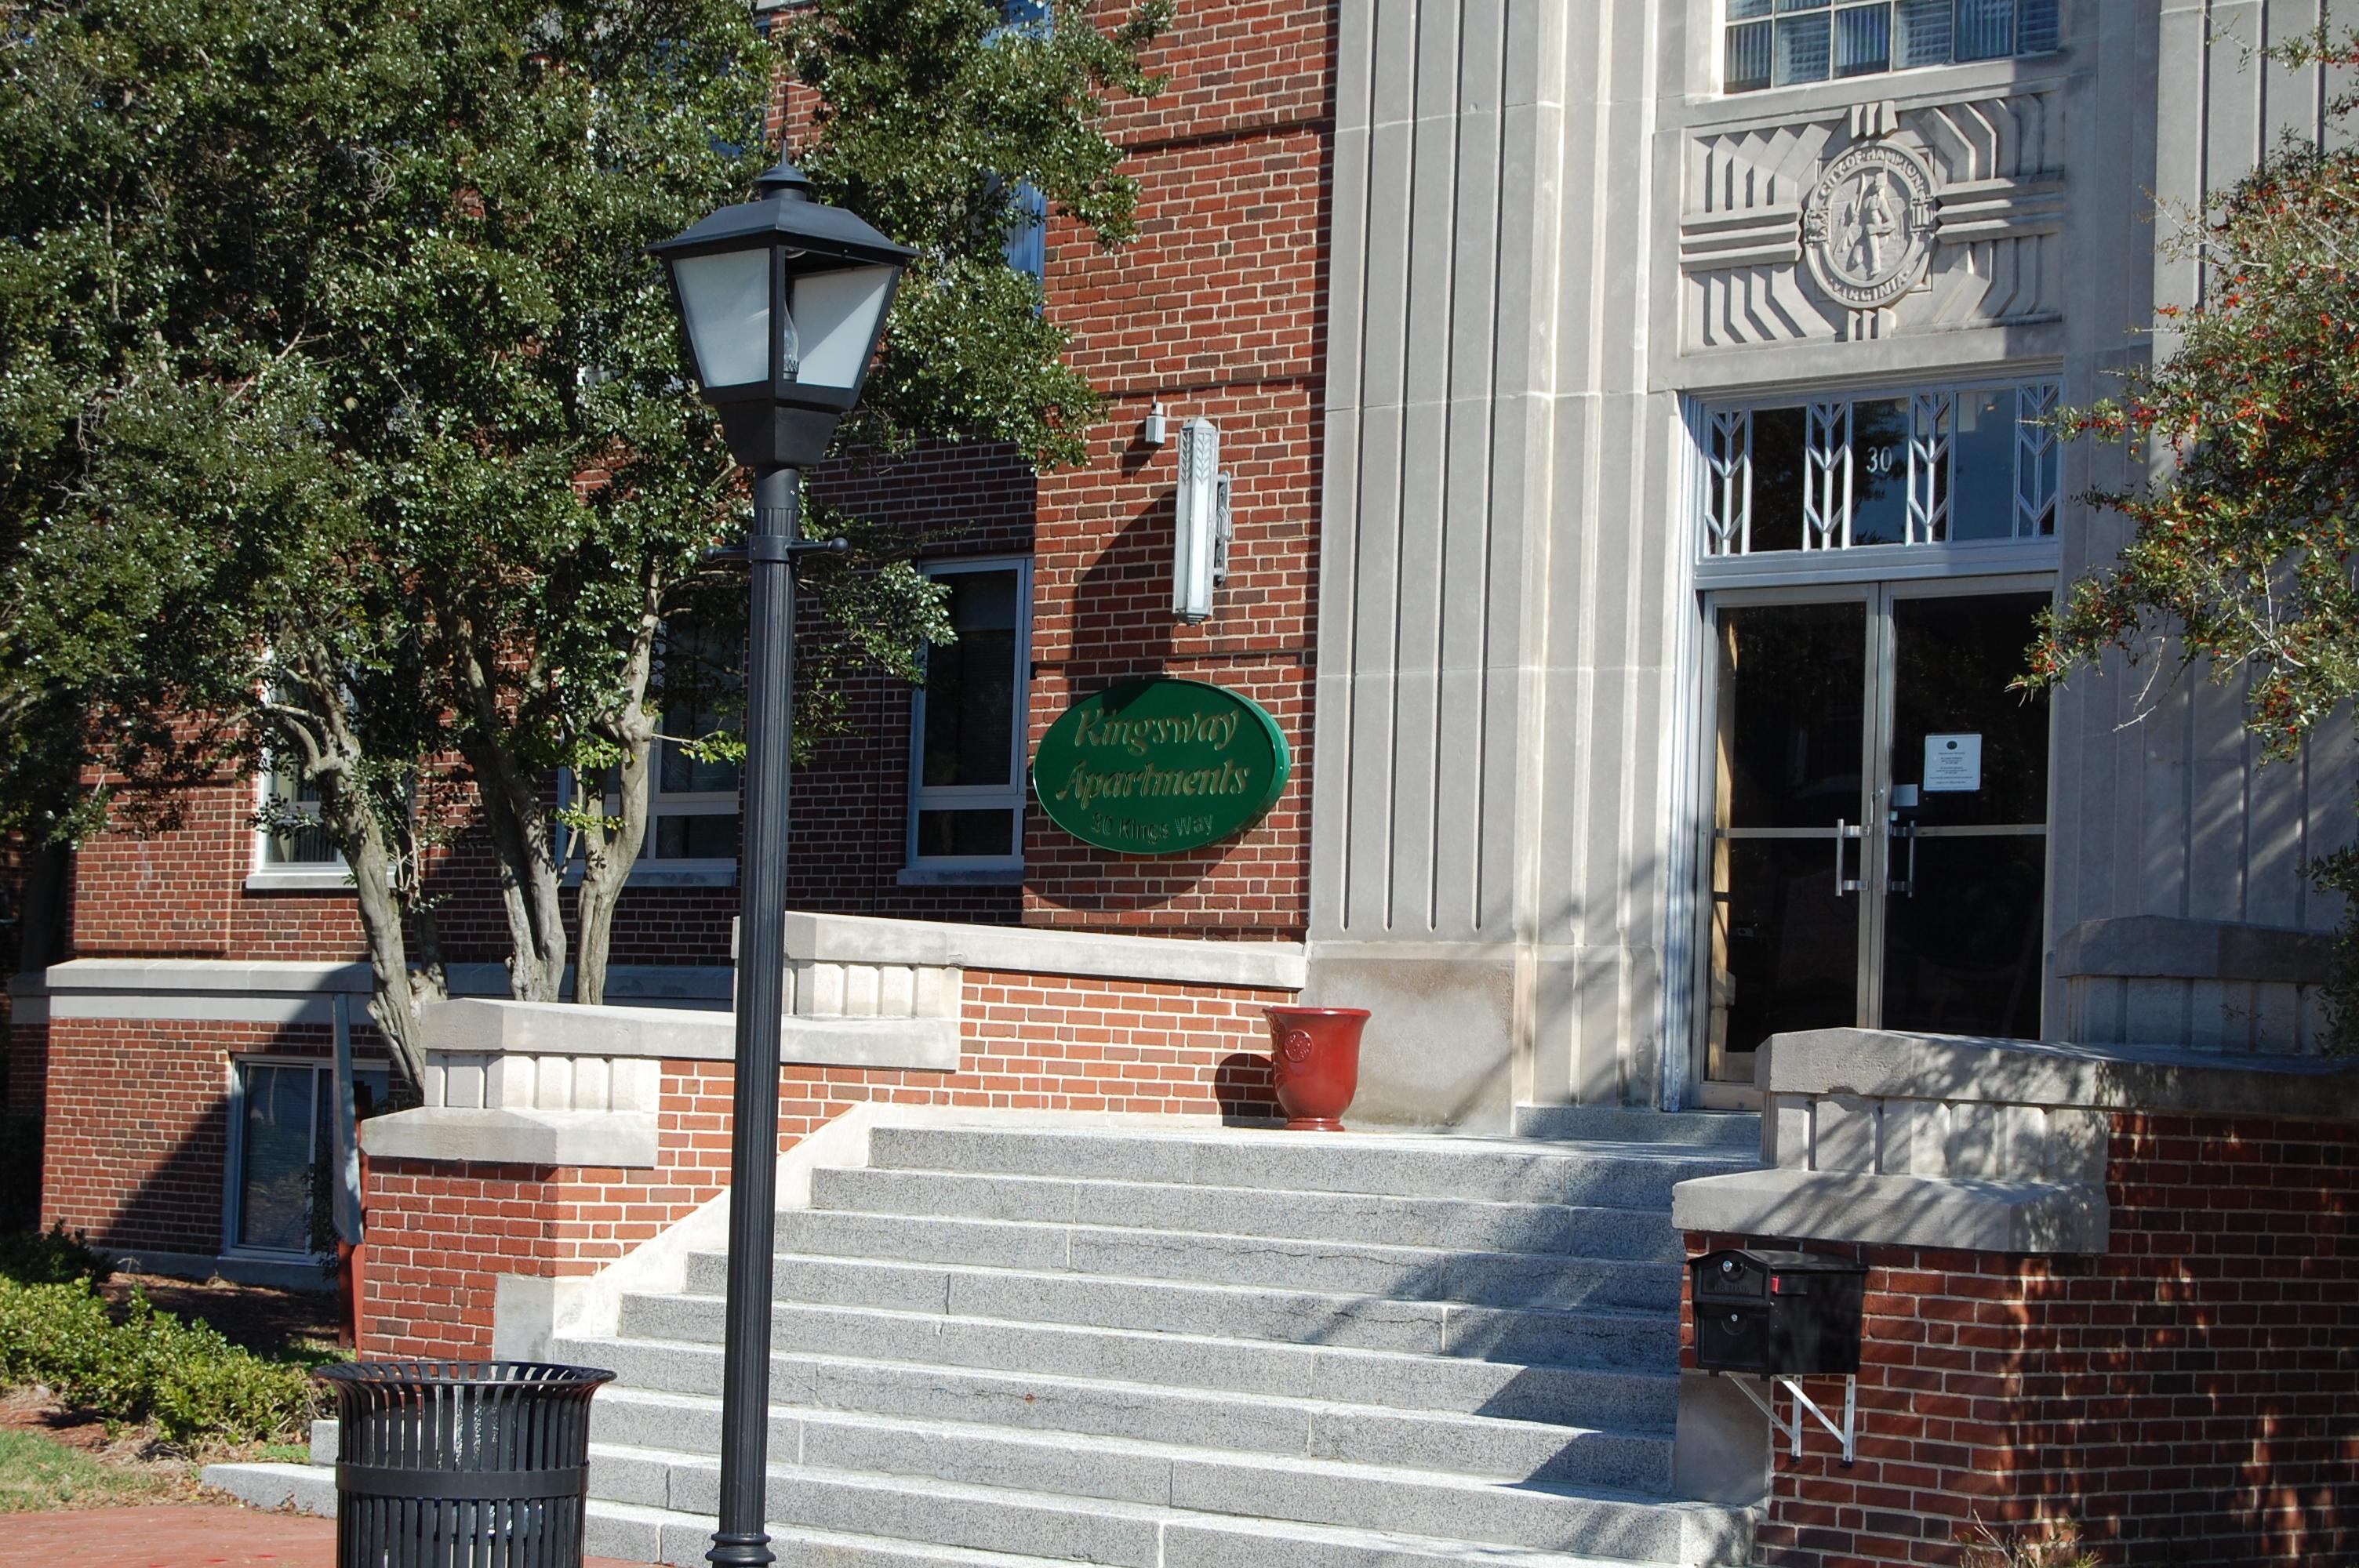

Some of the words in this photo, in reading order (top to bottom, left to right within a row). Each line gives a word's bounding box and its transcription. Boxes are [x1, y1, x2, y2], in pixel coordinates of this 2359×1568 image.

[1833, 273, 1906, 300] VIRGINIA
[1866, 446, 1892, 473] 30
[1074, 708, 1240, 757] Kingsway
[1056, 758, 1250, 810] Apartments
[1092, 812, 1113, 835] 30
[1118, 818, 1169, 845] Kings
[1174, 815, 1213, 837] Way
